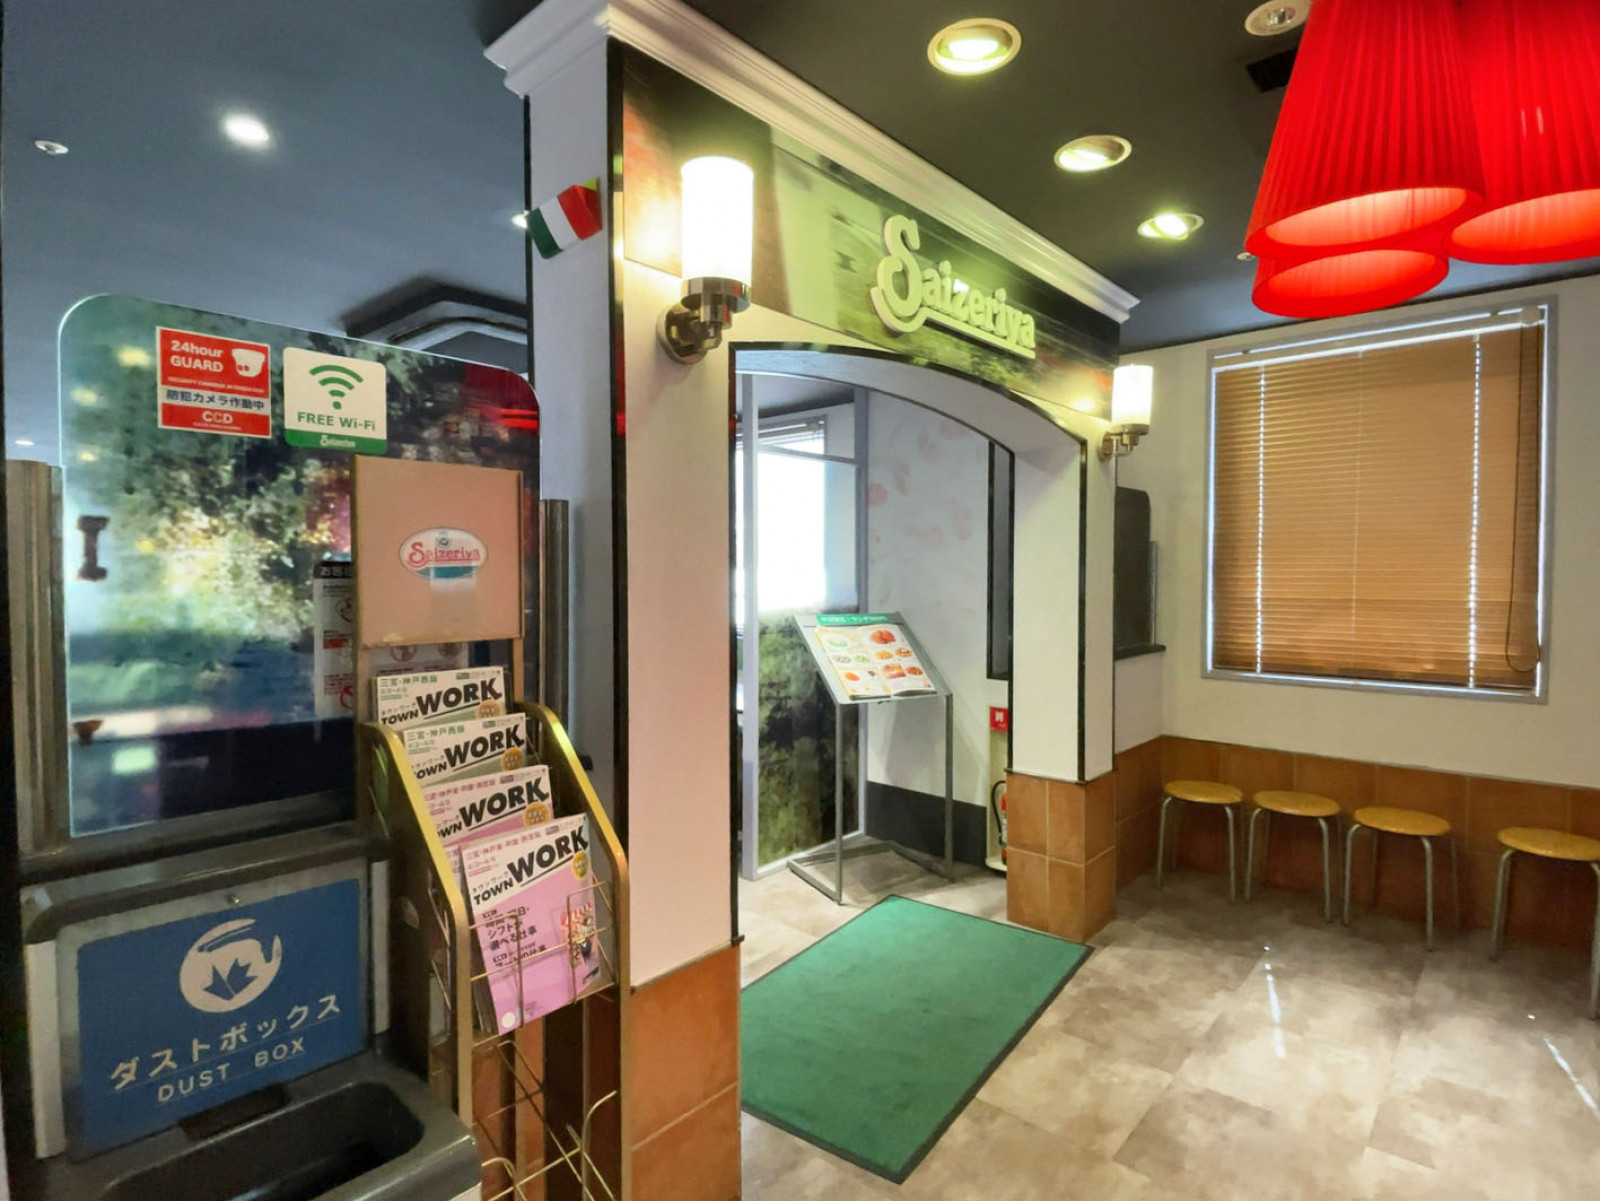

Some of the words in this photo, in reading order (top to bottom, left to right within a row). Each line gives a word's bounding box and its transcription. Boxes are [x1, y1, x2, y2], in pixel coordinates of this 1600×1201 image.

[871, 215, 1036, 356] Saizeriya
[170, 355, 224, 373] GUARD
[171, 340, 223, 358] 24hour
[166, 389, 264, 410] 防犯カメラ作動中
[202, 410, 234, 425] CCD
[297, 411, 335, 427] FREE
[339, 416, 376, 432] Wi-Fi
[381, 708, 419, 725] TOWN
[416, 678, 502, 716] WORK
[414, 762, 447, 780] OWN
[444, 724, 525, 768] WORK
[459, 777, 549, 828] WORK
[473, 877, 514, 905] TOWN
[507, 826, 588, 883] WORK
[110, 994, 341, 1091] ダストボックス
[158, 1063, 230, 1102] DUST
[254, 1037, 305, 1068] BOX
